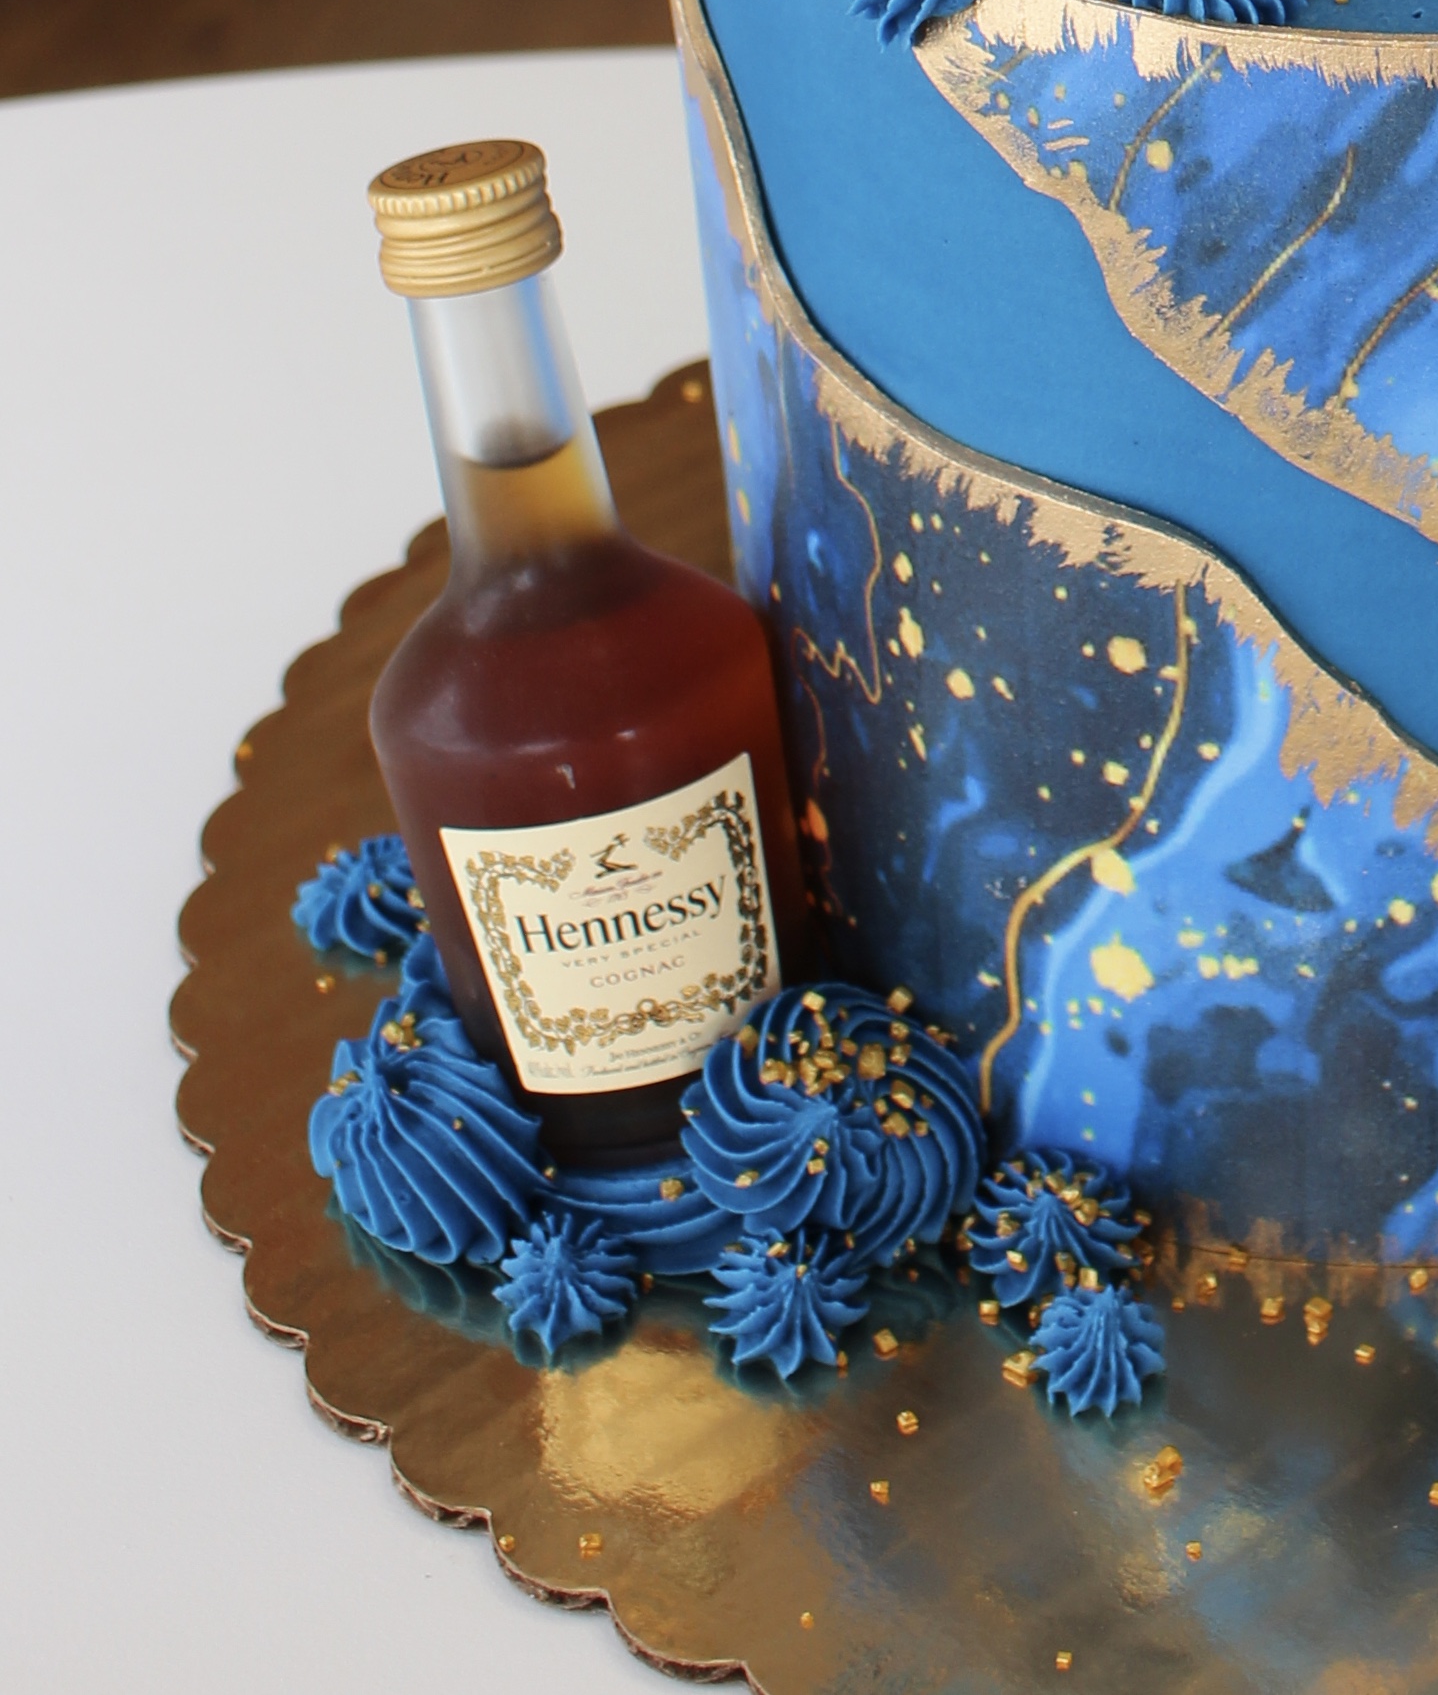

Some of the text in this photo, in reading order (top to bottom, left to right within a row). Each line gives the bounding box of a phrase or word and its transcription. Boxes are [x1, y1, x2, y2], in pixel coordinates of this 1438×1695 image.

[515, 874, 727, 953] Hennessy
[562, 930, 701, 968] VERY SPECIAL
[590, 955, 686, 988] COGNAC
